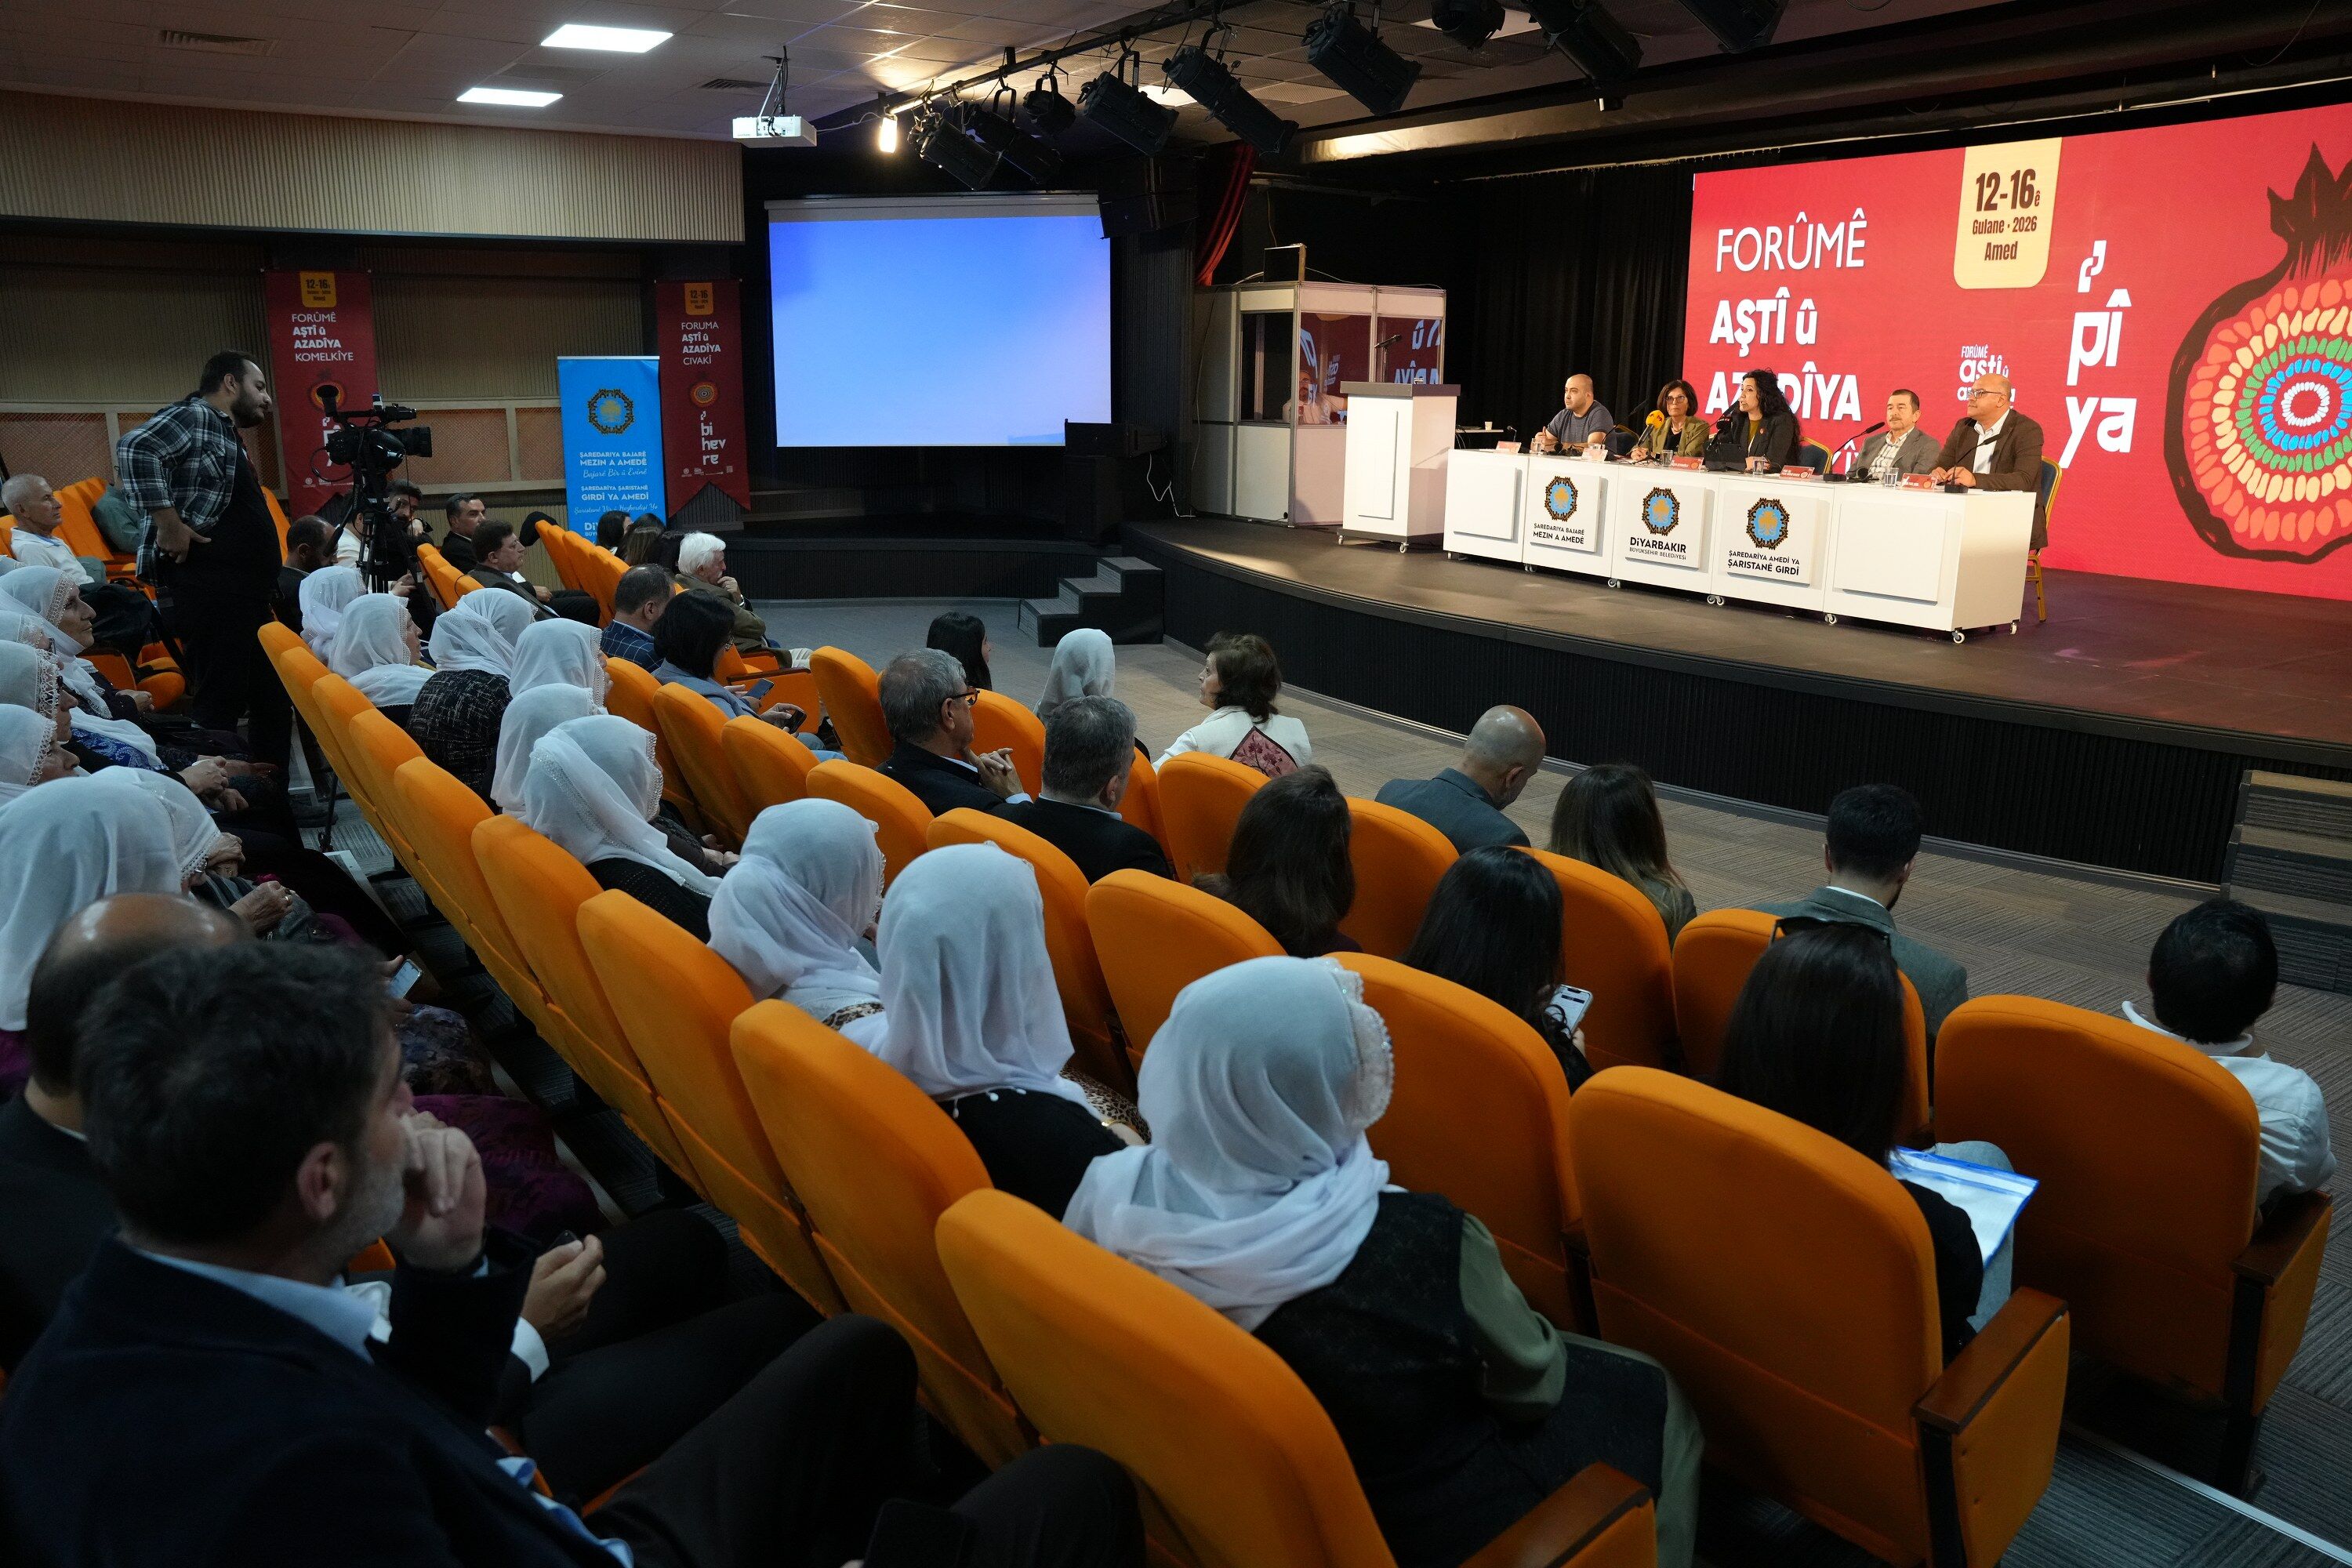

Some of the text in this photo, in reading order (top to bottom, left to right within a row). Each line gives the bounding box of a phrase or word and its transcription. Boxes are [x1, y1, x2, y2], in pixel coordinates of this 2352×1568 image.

[1973, 216, 2038, 235] Gulane 2026
[1716, 207, 1867, 273] FORÛMÊ
[1984, 241, 2018, 261] Amed
[292, 311, 337, 323] FORÛMÊ
[1709, 286, 1818, 358] AŞTÎ û
[292, 325, 317, 338] AŞTÎ
[681, 321, 719, 330] FORUMA
[294, 337, 342, 349] AZADÎYA
[681, 332, 701, 343] AŞTÎ
[682, 343, 721, 354] AZADÎYA
[296, 350, 354, 361] KOMELKÎYE
[700, 422, 713, 436] bi
[2059, 396, 2137, 469] ya
[702, 437, 726, 451] hev
[702, 454, 719, 466] re
[1533, 531, 1553, 540] MEZIN
[1561, 535, 1584, 544] AMEDÊ
[1727, 559, 1800, 575] ŞARISTANÊ GIRDÎ
